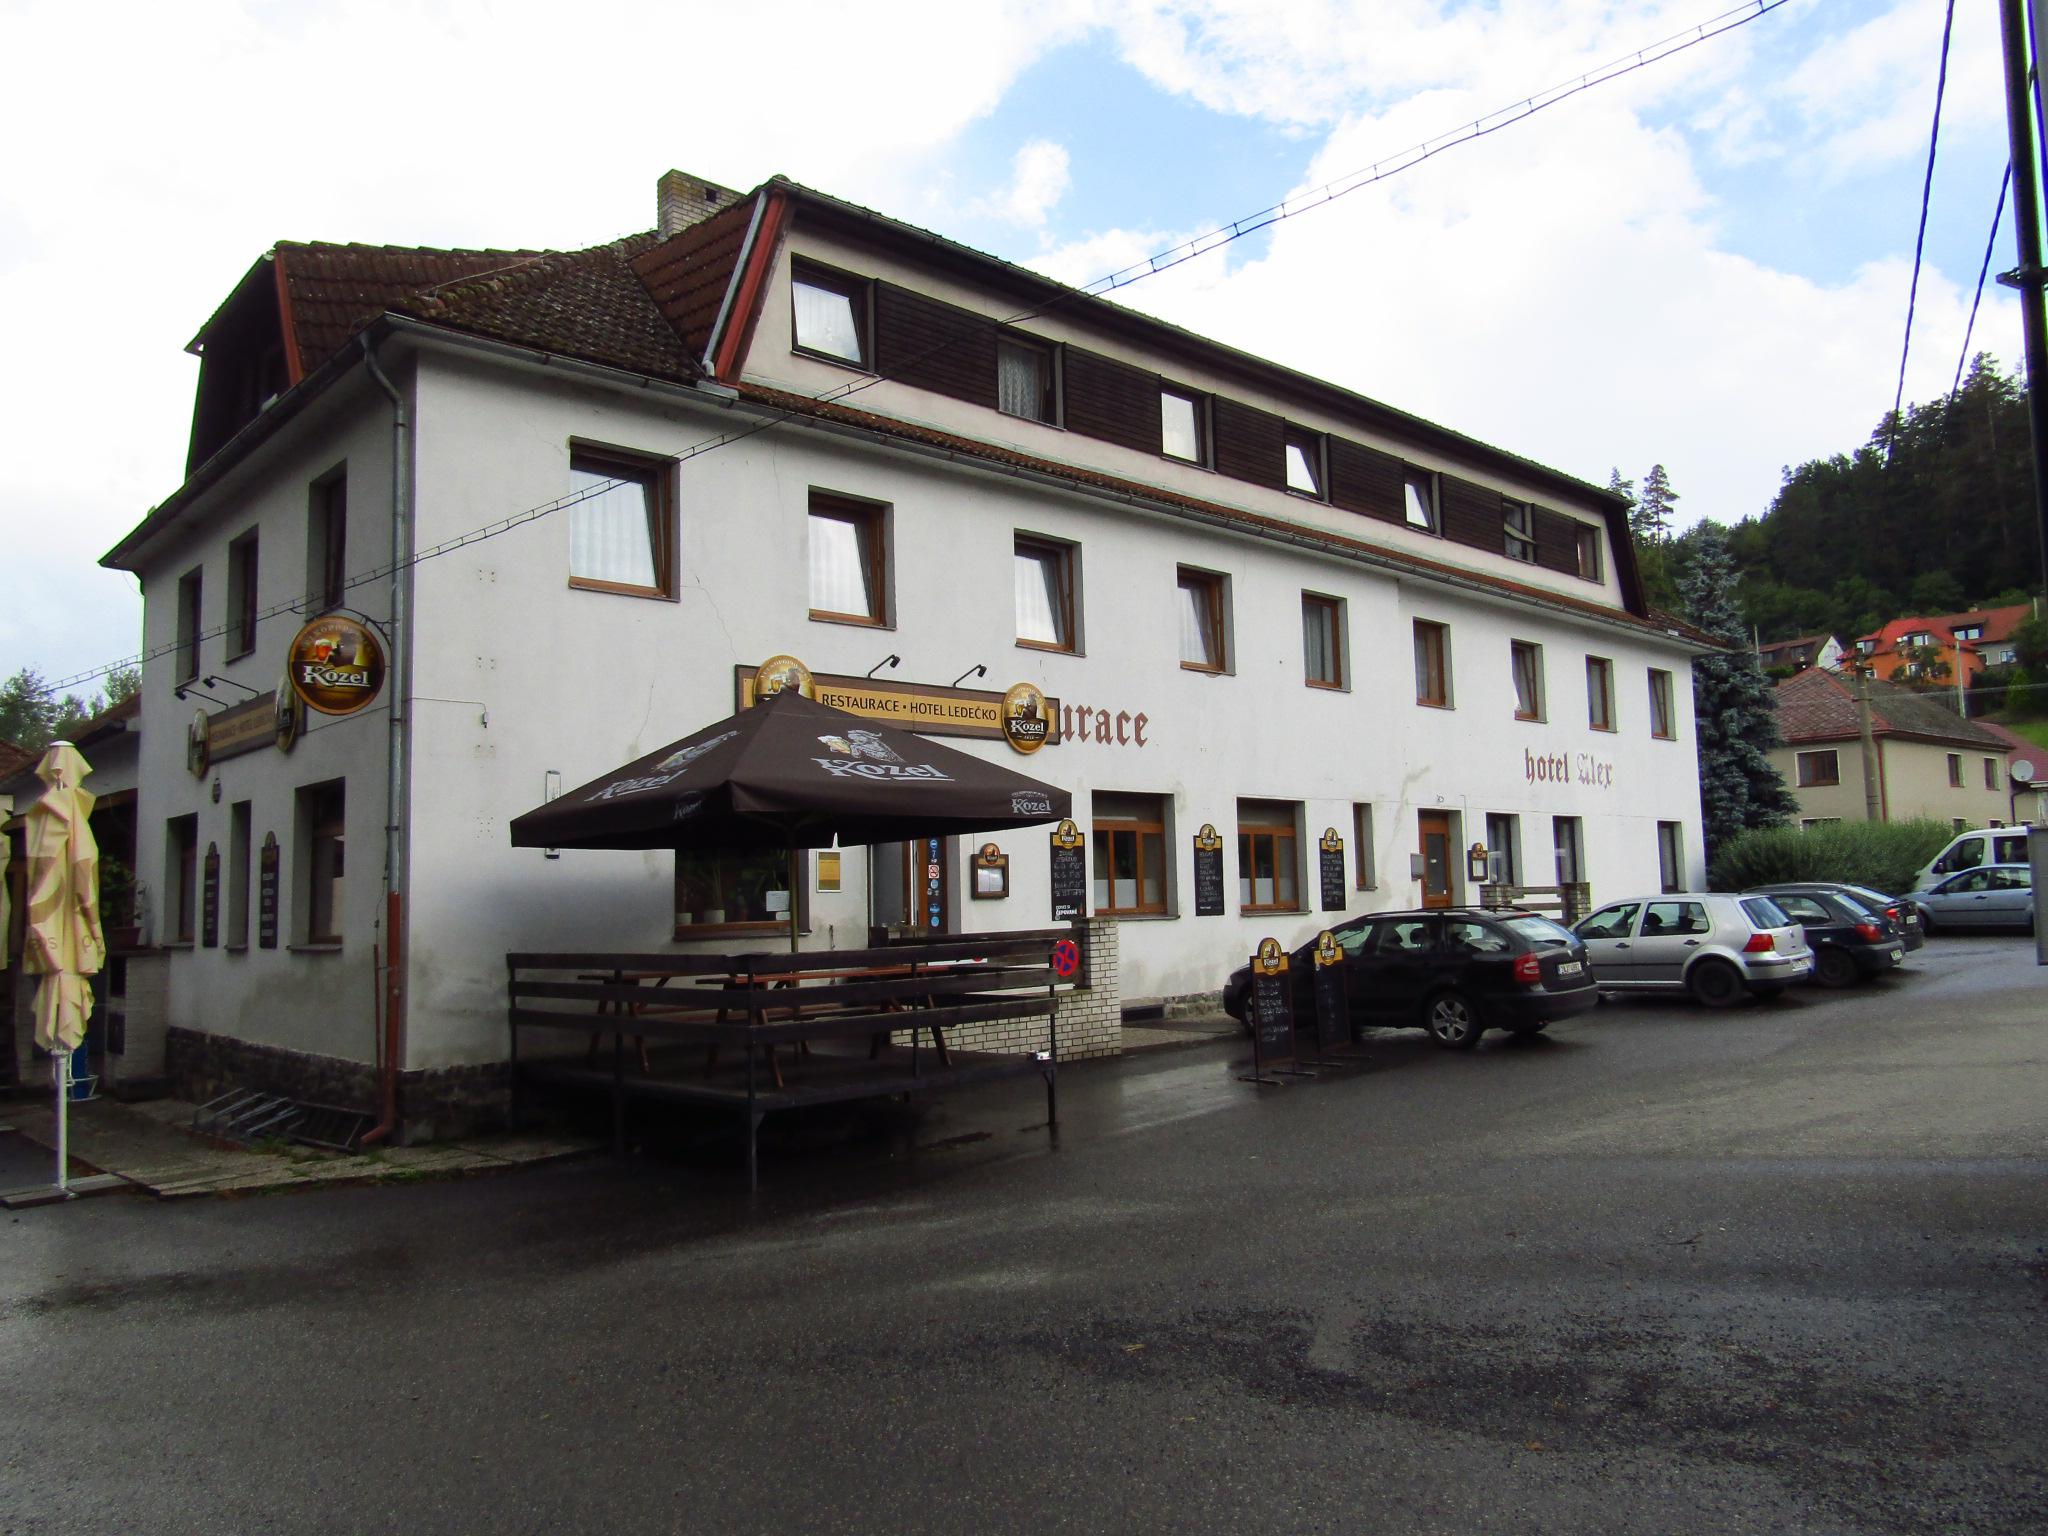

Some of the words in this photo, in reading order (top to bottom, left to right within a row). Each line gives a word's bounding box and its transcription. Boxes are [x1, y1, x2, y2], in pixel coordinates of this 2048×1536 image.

[303, 665, 370, 687] Kozel
[822, 693, 900, 712] RESTAURACE
[910, 702, 946, 716] HOTEL
[948, 703, 997, 721] LEDEČKO
[1010, 719, 1045, 735] Kozel
[811, 758, 952, 781] Kozel
[1524, 746, 1570, 786] hotel
[1011, 798, 1053, 815] Kozel
